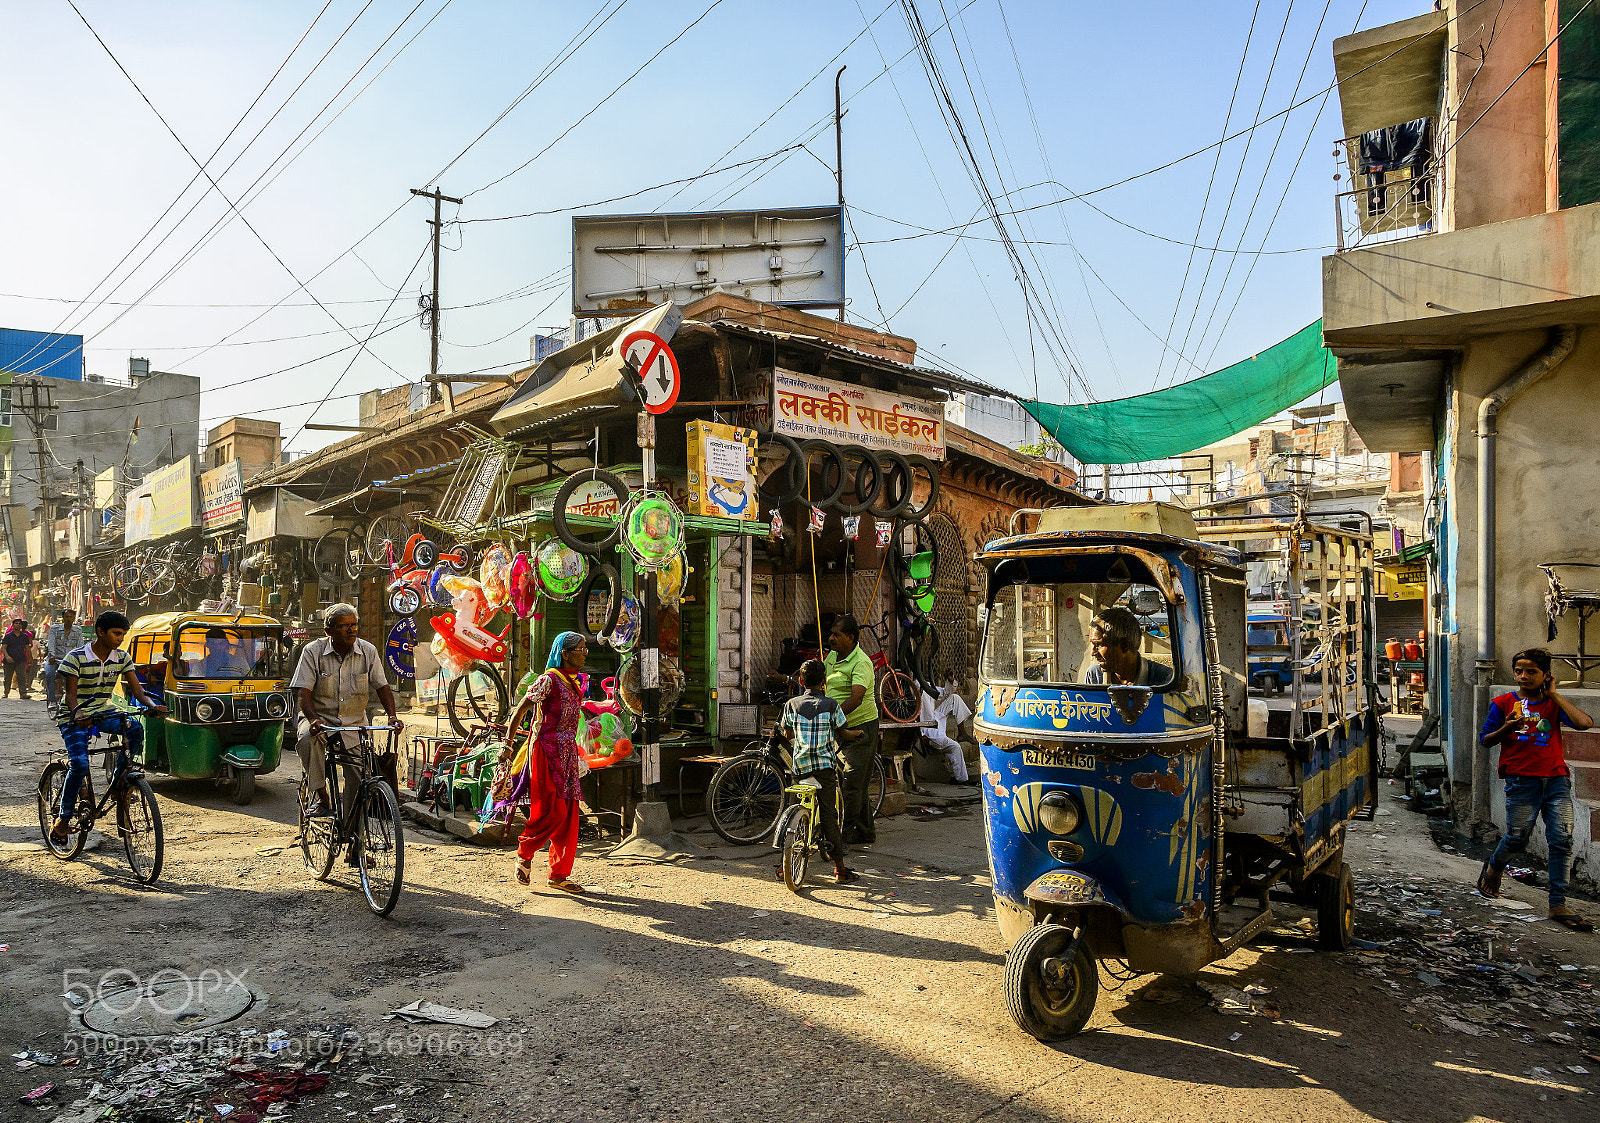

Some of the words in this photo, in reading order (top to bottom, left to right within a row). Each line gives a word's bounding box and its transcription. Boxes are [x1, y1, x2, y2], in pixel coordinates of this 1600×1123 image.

[777, 390, 853, 428] लक्की
[855, 404, 942, 444] साईकल
[1060, 691, 1112, 726] कैरियर
